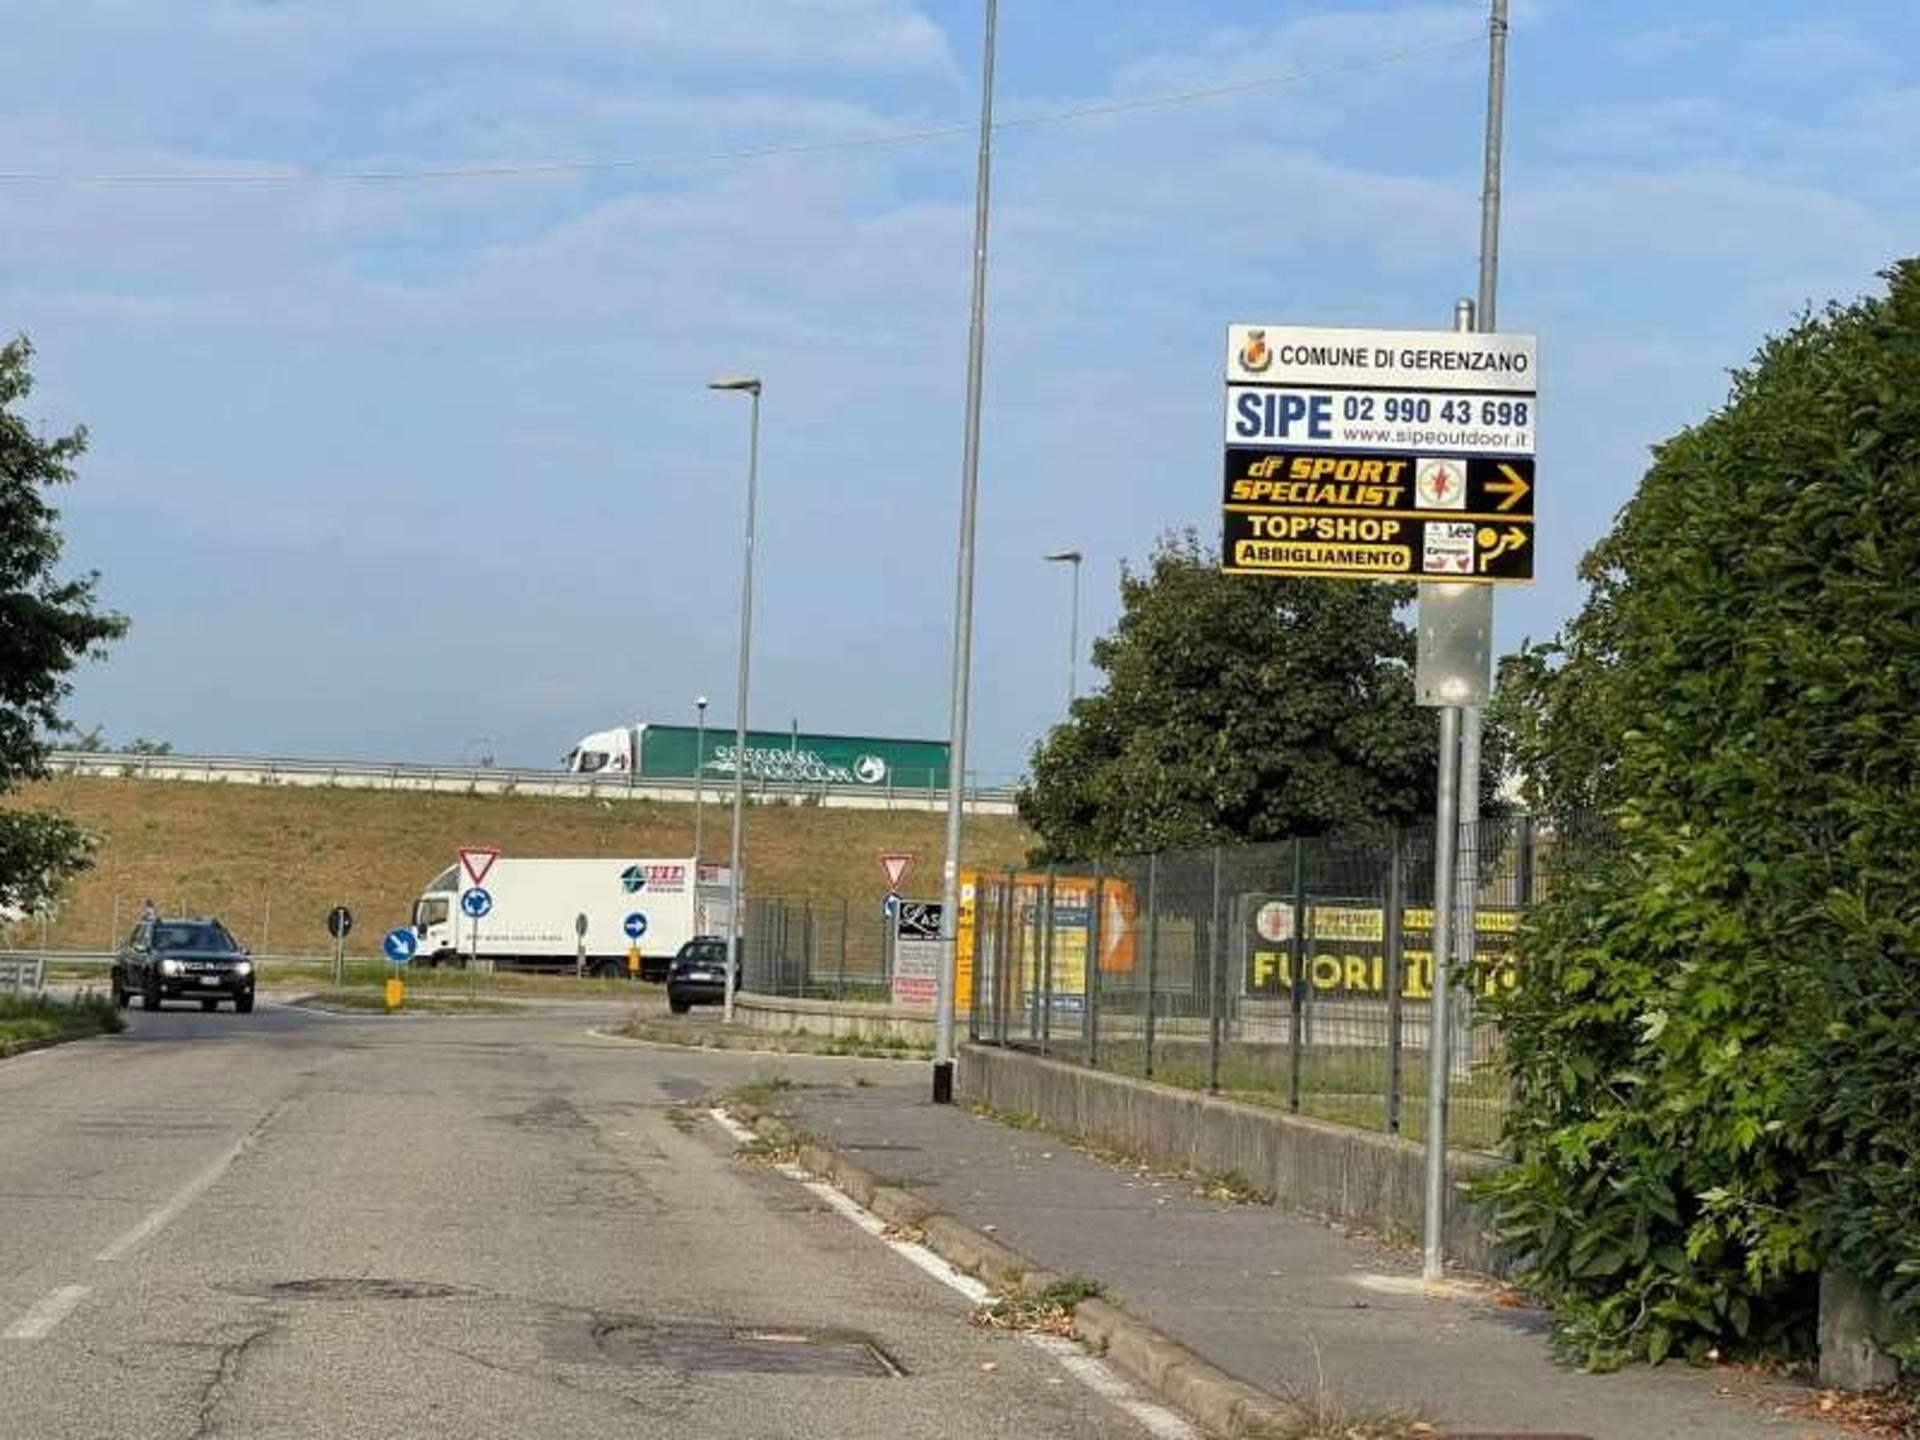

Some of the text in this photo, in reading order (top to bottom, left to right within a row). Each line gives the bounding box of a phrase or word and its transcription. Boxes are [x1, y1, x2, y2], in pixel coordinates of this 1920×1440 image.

[1281, 346, 1528, 373] COMUNE DI GERENZANO
[1235, 393, 1528, 439] SIPE 02 990 43 698
[1343, 427, 1528, 448] www.sipeoutdoor.it
[1290, 457, 1407, 484] SPORT
[1231, 479, 1405, 507] SPECIALIST
[1247, 515, 1400, 541] TOP'SHOP
[1242, 544, 1405, 566] ABBIGLIAMENTO
